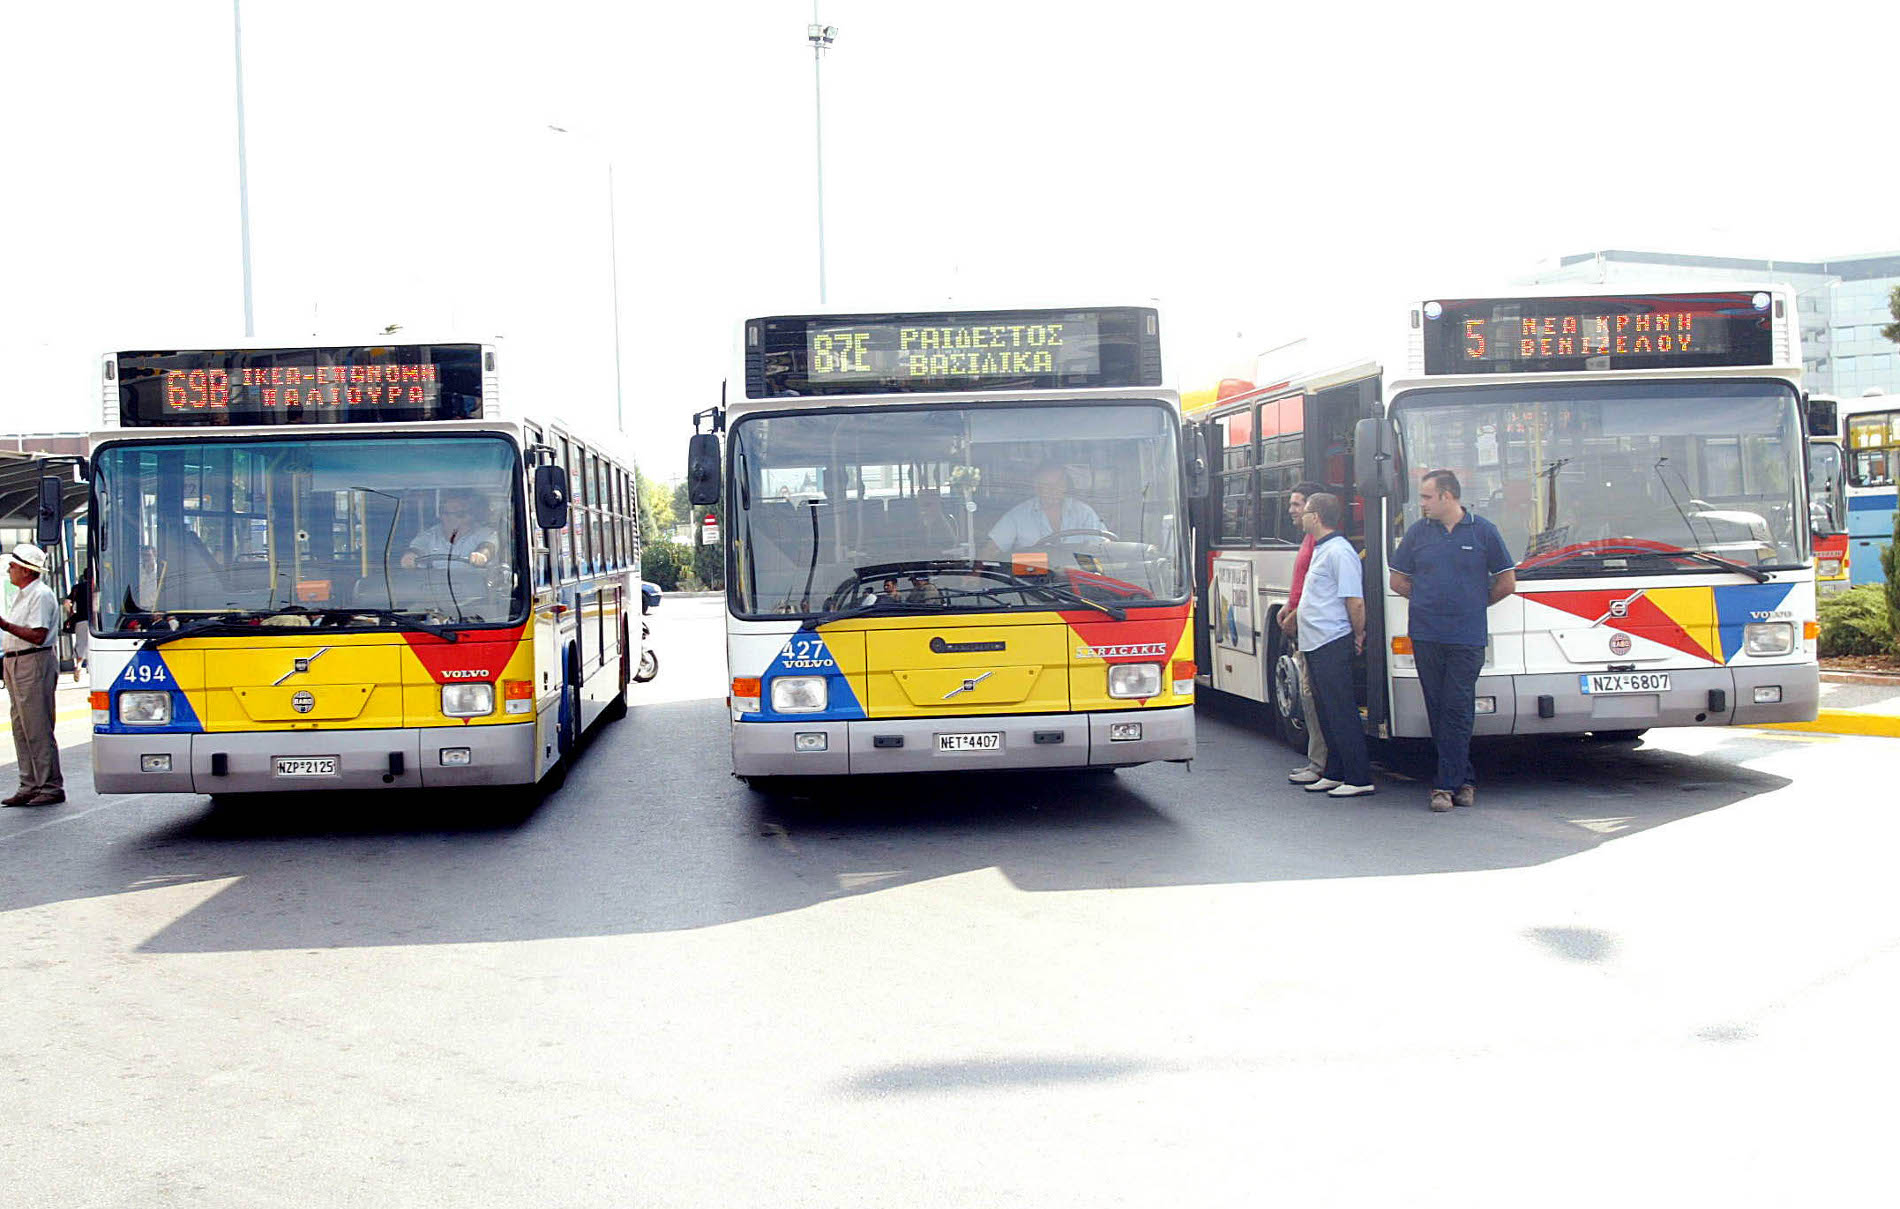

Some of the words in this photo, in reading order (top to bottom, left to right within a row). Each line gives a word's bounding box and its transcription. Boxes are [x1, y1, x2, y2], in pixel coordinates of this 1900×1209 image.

[901, 324, 1063, 350] ΡΑΙΔΕΣΤΟΣ
[1467, 319, 1486, 358] 5
[910, 351, 1052, 376] ΒΑΣΙΛΙΚΑ
[781, 641, 823, 660] 427
[1075, 644, 1166, 657] SARACAKIS
[782, 659, 833, 668] VOLVO
[124, 665, 166, 683] 494
[441, 669, 490, 678] VOLVO
[1593, 674, 1669, 692] NZX-6807
